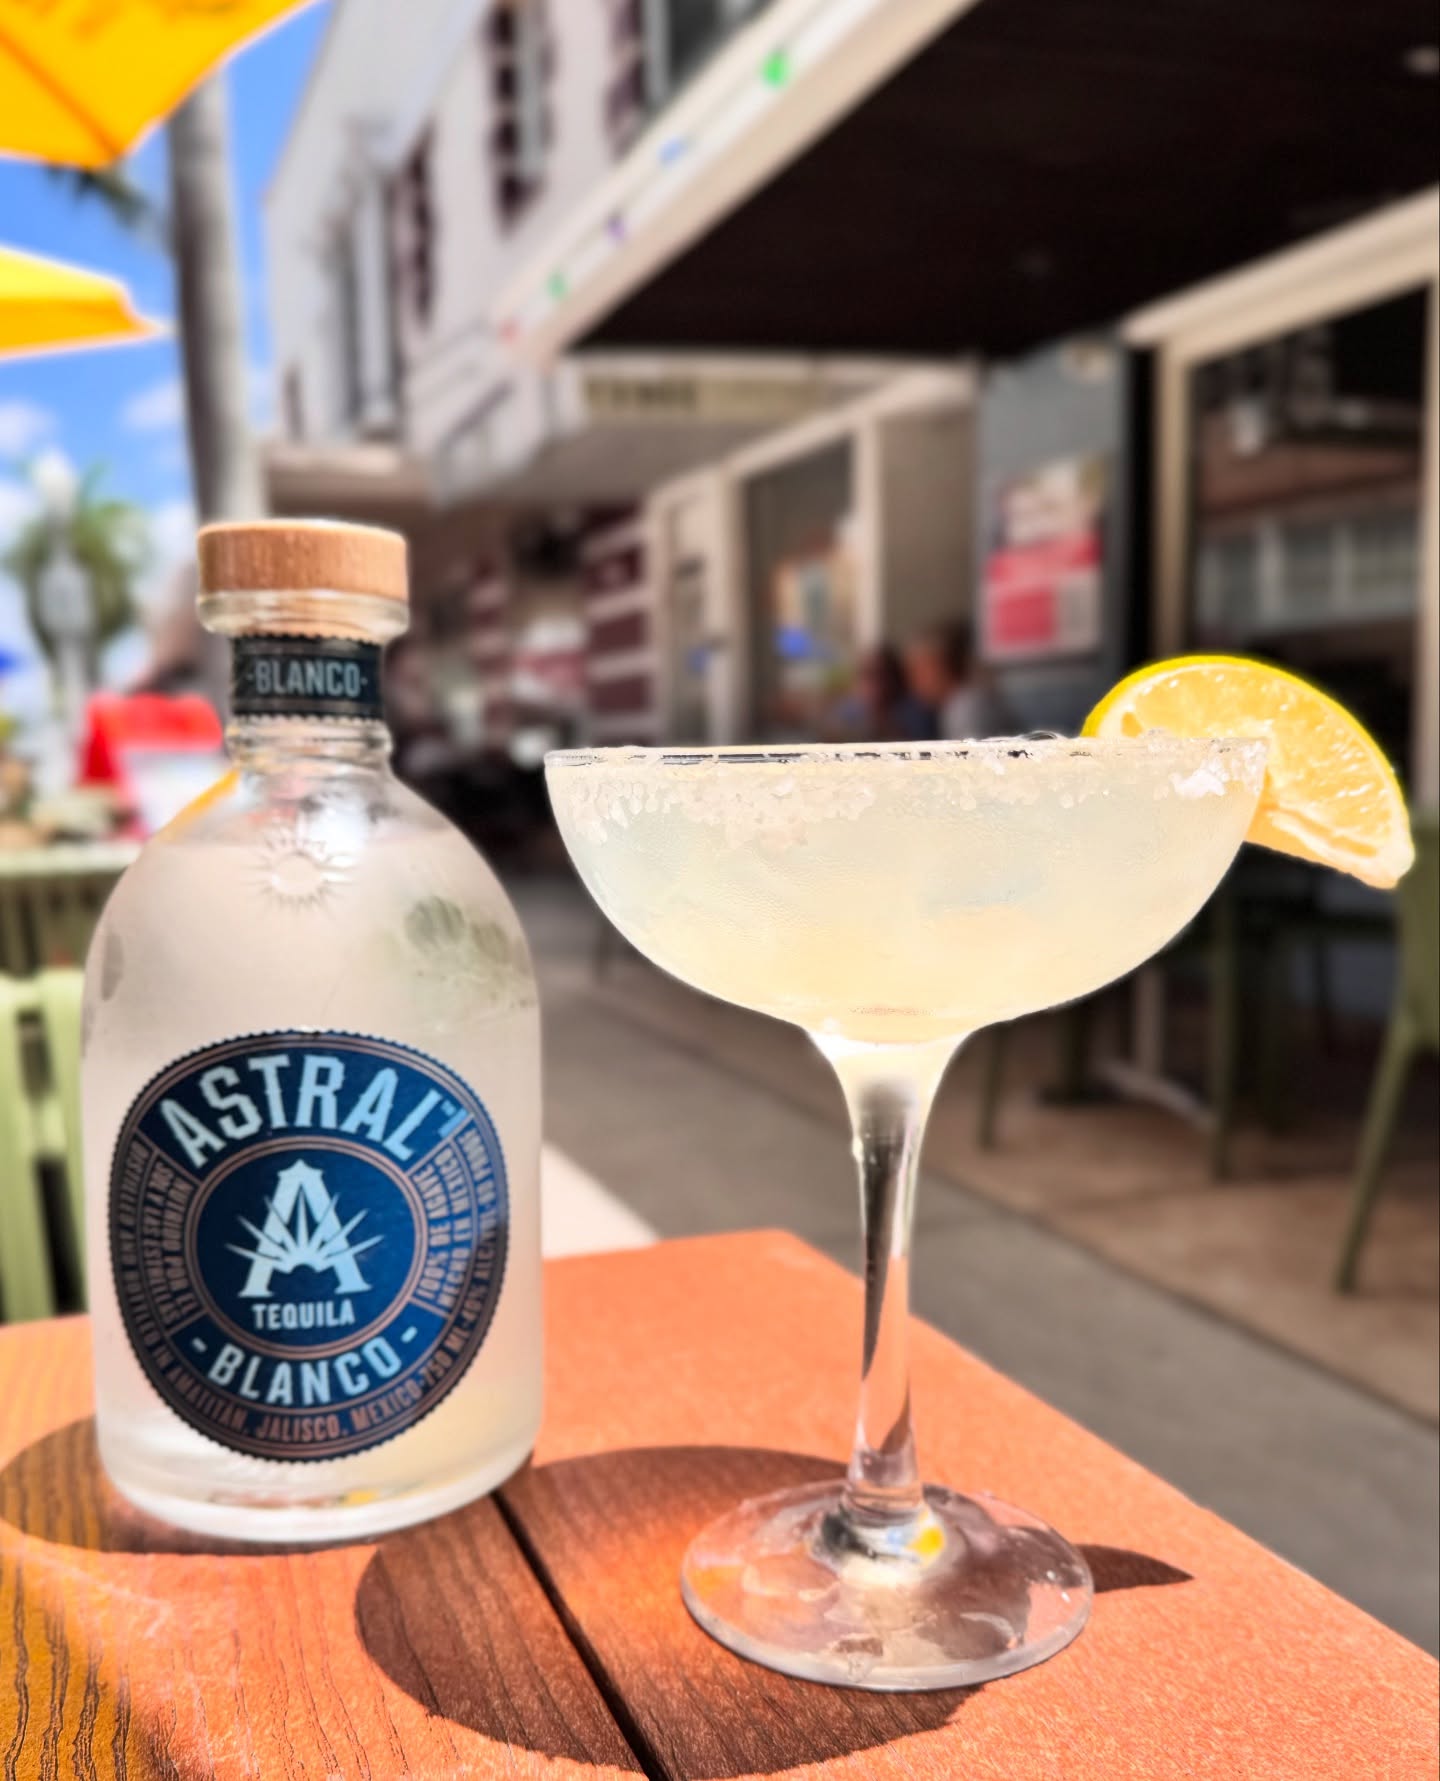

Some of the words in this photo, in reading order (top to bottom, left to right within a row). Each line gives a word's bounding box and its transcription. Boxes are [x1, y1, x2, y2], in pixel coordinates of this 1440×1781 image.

[255, 660, 361, 698] BLANCO
[160, 1054, 443, 1168] ASTRAL
[413, 1165, 449, 1219] AGAVE
[434, 1148, 470, 1214] MEXICO
[430, 1221, 452, 1246] DE
[453, 1216, 473, 1242] EN
[416, 1251, 449, 1299] 100%
[436, 1247, 471, 1309] HECHO
[253, 1301, 356, 1331] TEQUILA
[207, 1337, 403, 1406] BLANCO
